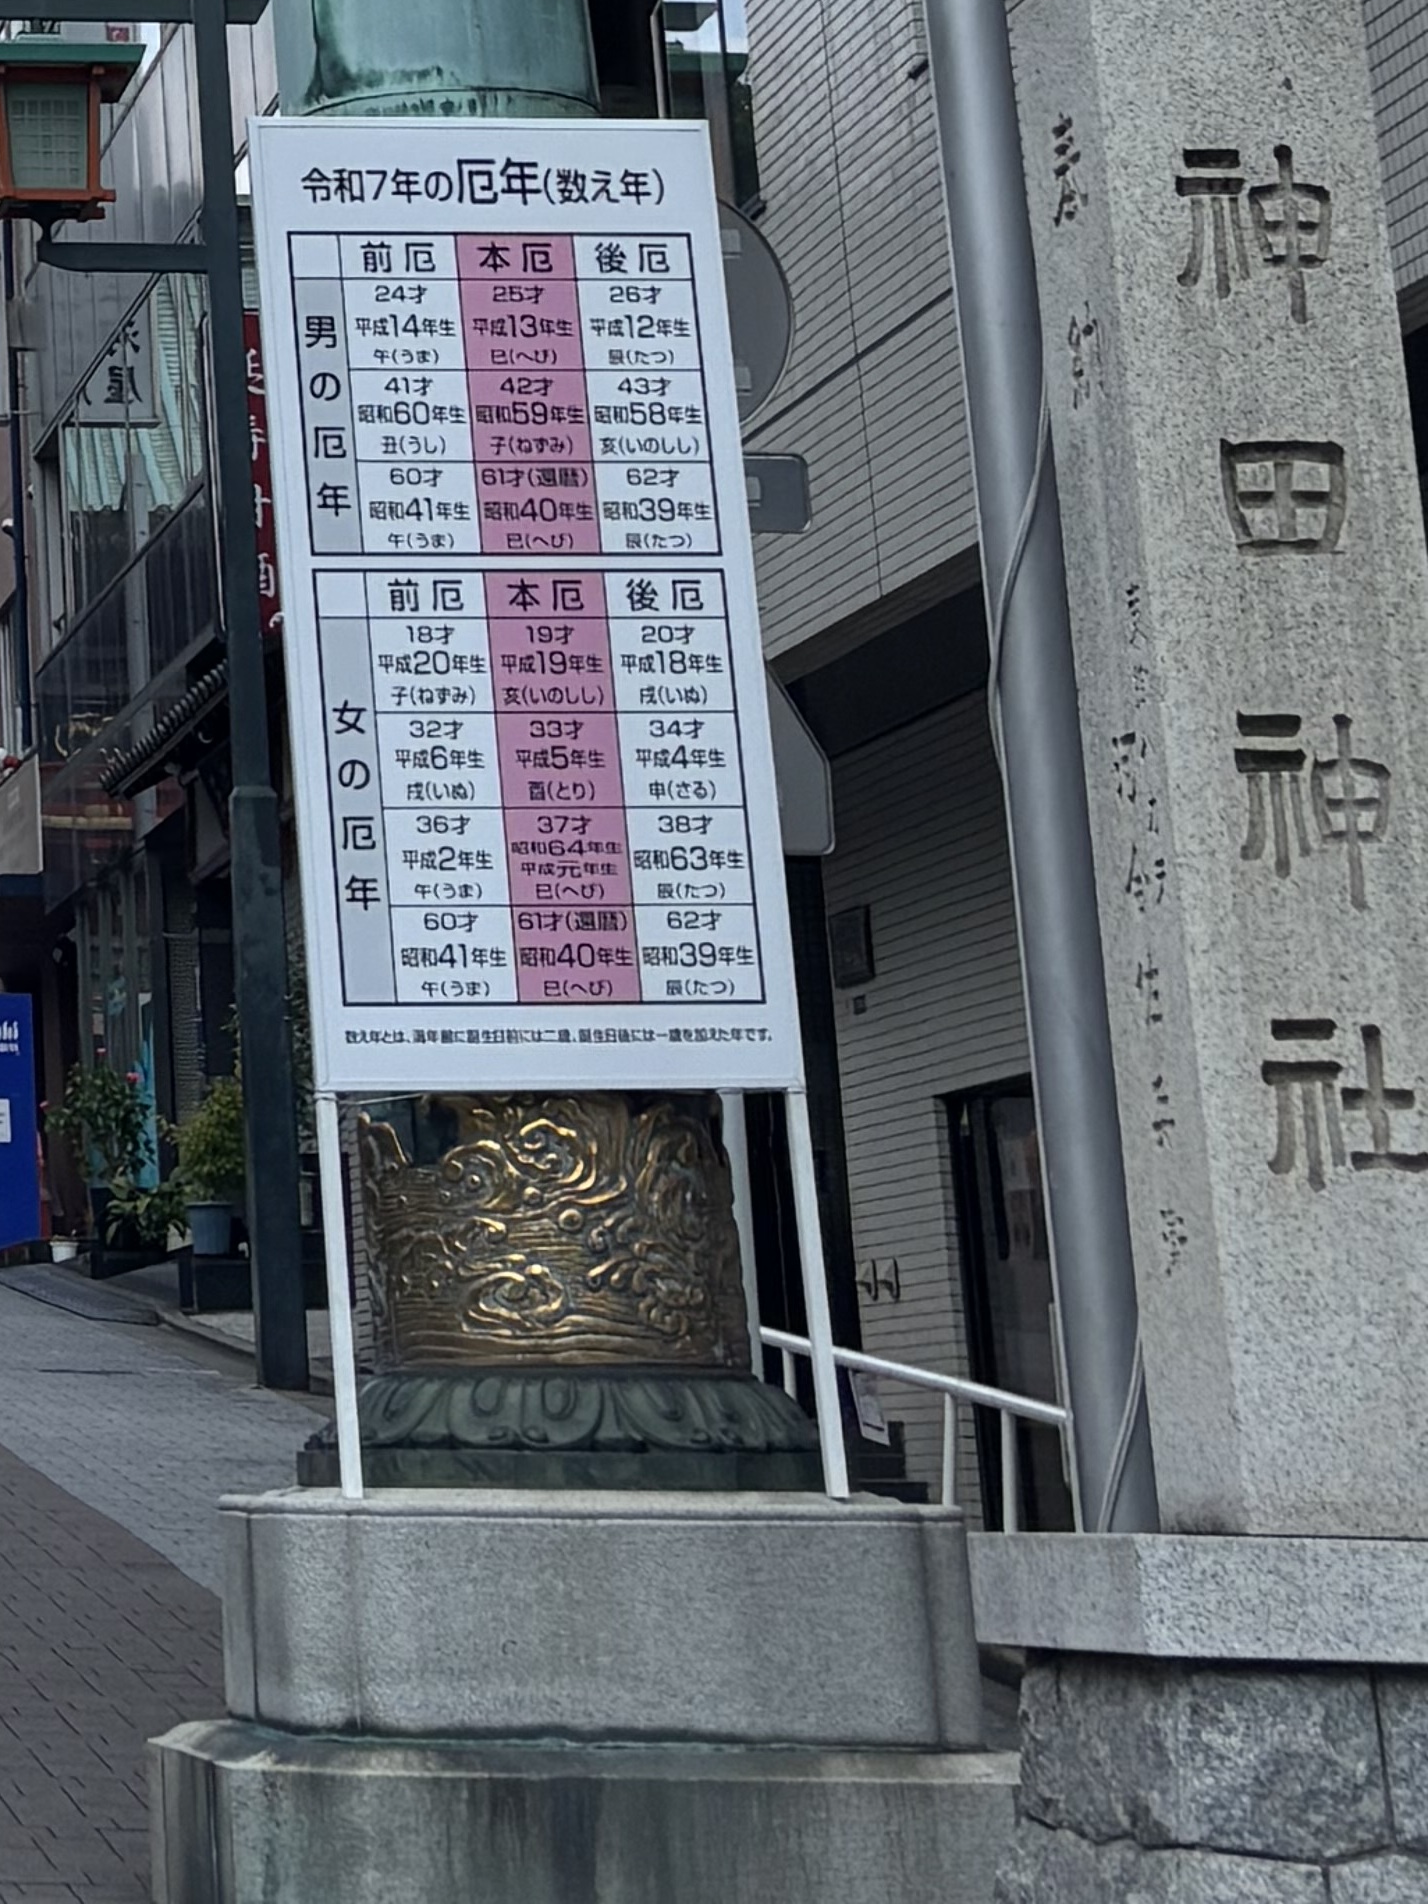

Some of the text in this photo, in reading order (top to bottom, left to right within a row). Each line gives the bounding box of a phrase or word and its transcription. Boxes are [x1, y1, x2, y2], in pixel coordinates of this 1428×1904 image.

[301, 158, 665, 206] 令和7年の厄年(数え年)
[361, 242, 670, 274] 前厄 本厄 後厄
[374, 285, 662, 303] 24才 25才 26才
[355, 314, 691, 340] 平成14年生 平成13年生 平成12年生
[384, 377, 670, 396] 41才 42才 43才
[305, 316, 352, 518] 男の厄年
[358, 403, 703, 427] 昭和60年生 昭和59年生 昭和58年生
[381, 436, 699, 457] 丑(うし) 子(ねずみ) 亥(いのしし)
[389, 467, 679, 488] 60才 61才(還暦) 62才
[369, 498, 713, 522] 昭和41年生 昭和40年生 昭和39年生
[388, 580, 703, 612] 前厄 本厄 後厄
[406, 626, 695, 644] 18才 19才 20才
[377, 650, 723, 675] 平成20年生 平成19年生 平成18年生
[1174, 142, 1428, 1191] 神田神社
[391, 686, 708, 707] 子(ねずみ) 亥(いのしし) 戌(いぬ)
[408, 720, 704, 739] 32才 33才 34才
[394, 746, 727, 770] 平成6年生 平成5年生 平成4年生
[332, 700, 381, 912] 女の厄年
[415, 815, 713, 835] 36才 37才 38才
[401, 840, 745, 872] 平成2年生 昭和64年生 昭和63年生
[520, 860, 619, 879] 平成元年生
[423, 910, 722, 935] 60才 61才(還暦) 62才
[401, 943, 755, 970] 昭和41年生 昭和40年生 昭和39年生
